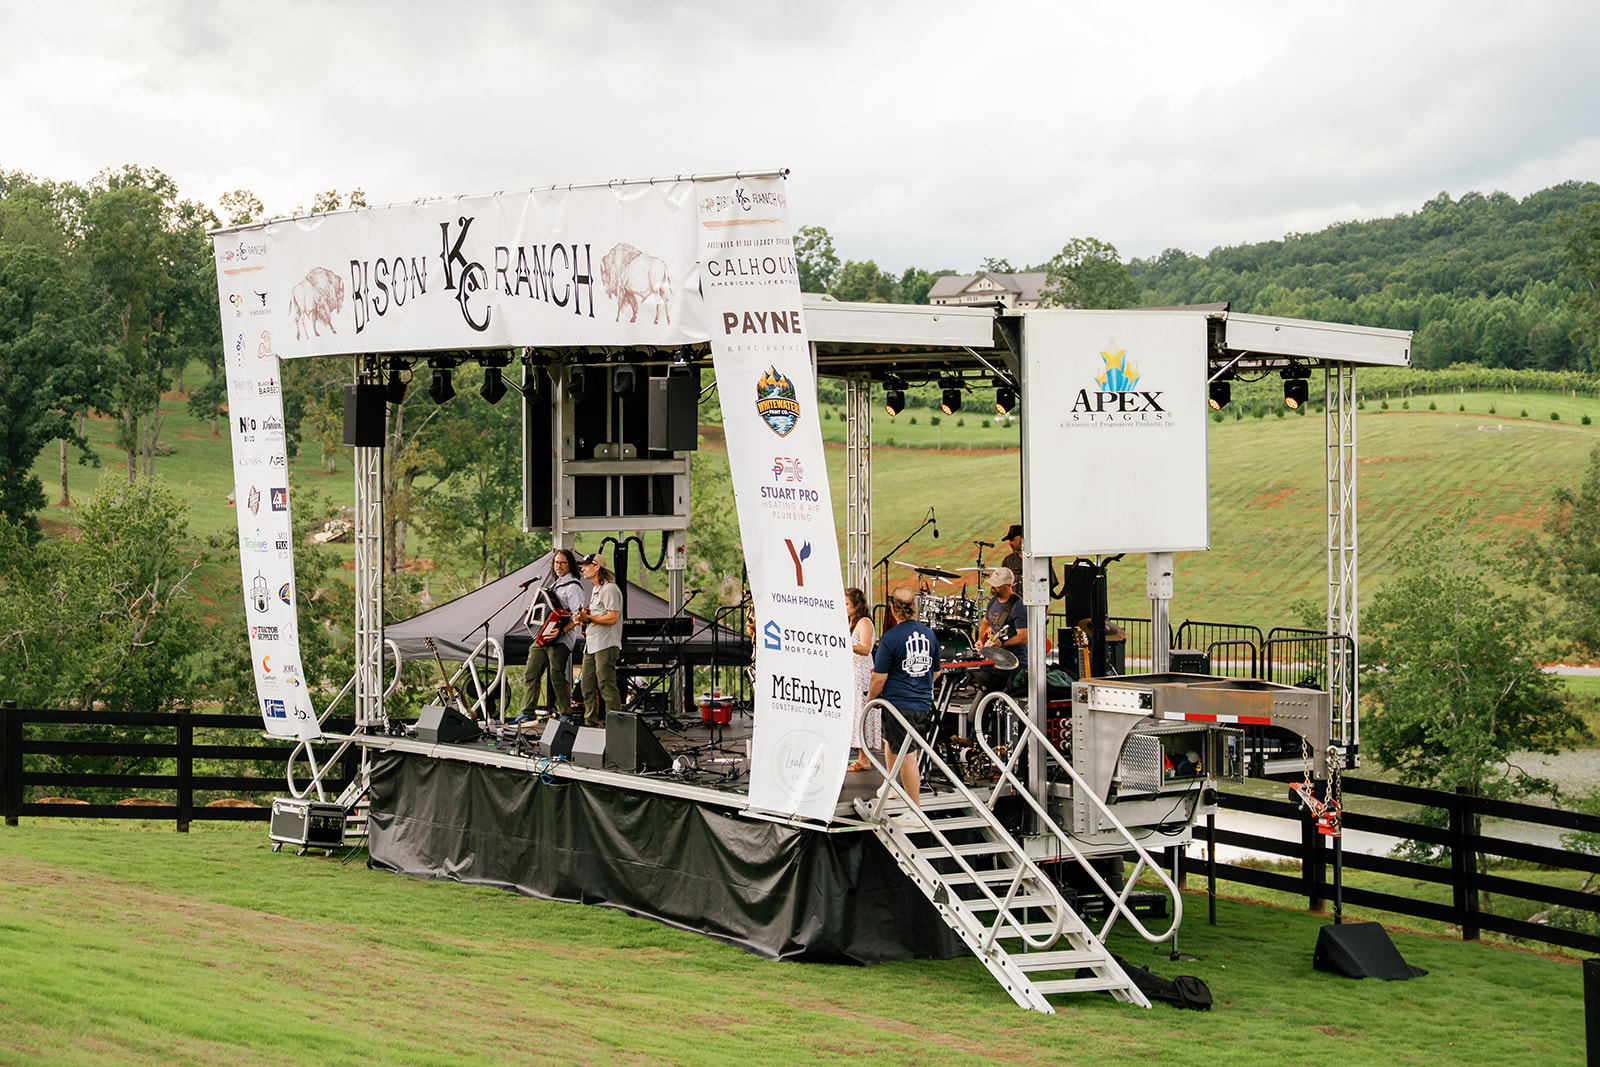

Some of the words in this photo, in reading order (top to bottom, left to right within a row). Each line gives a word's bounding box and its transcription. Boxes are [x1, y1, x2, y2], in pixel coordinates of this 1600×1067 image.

[753, 238, 774, 247] LEGACY
[707, 257, 797, 277] CALHOUN
[350, 256, 427, 335] BISON
[495, 243, 595, 318] RANCH
[710, 280, 755, 288] AMERICAN
[723, 310, 802, 335] PAYNE
[727, 345, 759, 353] REAL
[766, 344, 806, 353] ESTATE
[758, 399, 799, 415] WHITEWATER
[1070, 388, 1166, 412] APEX
[1072, 413, 1163, 421] STAGES
[760, 486, 796, 501] STUART
[798, 489, 819, 502] PRO
[762, 500, 797, 511] HEATING
[799, 503, 805, 511] &
[807, 504, 820, 513] AIR
[772, 510, 812, 522] PLUMBING
[771, 592, 797, 605] YONAH
[798, 596, 835, 610] PROPANE
[784, 629, 846, 649] STOCKTON
[785, 645, 829, 657] MORTGAGE
[771, 674, 842, 712] McEntyre
[771, 701, 816, 715] CONSTRUCTION
[823, 709, 842, 719] GROUP
